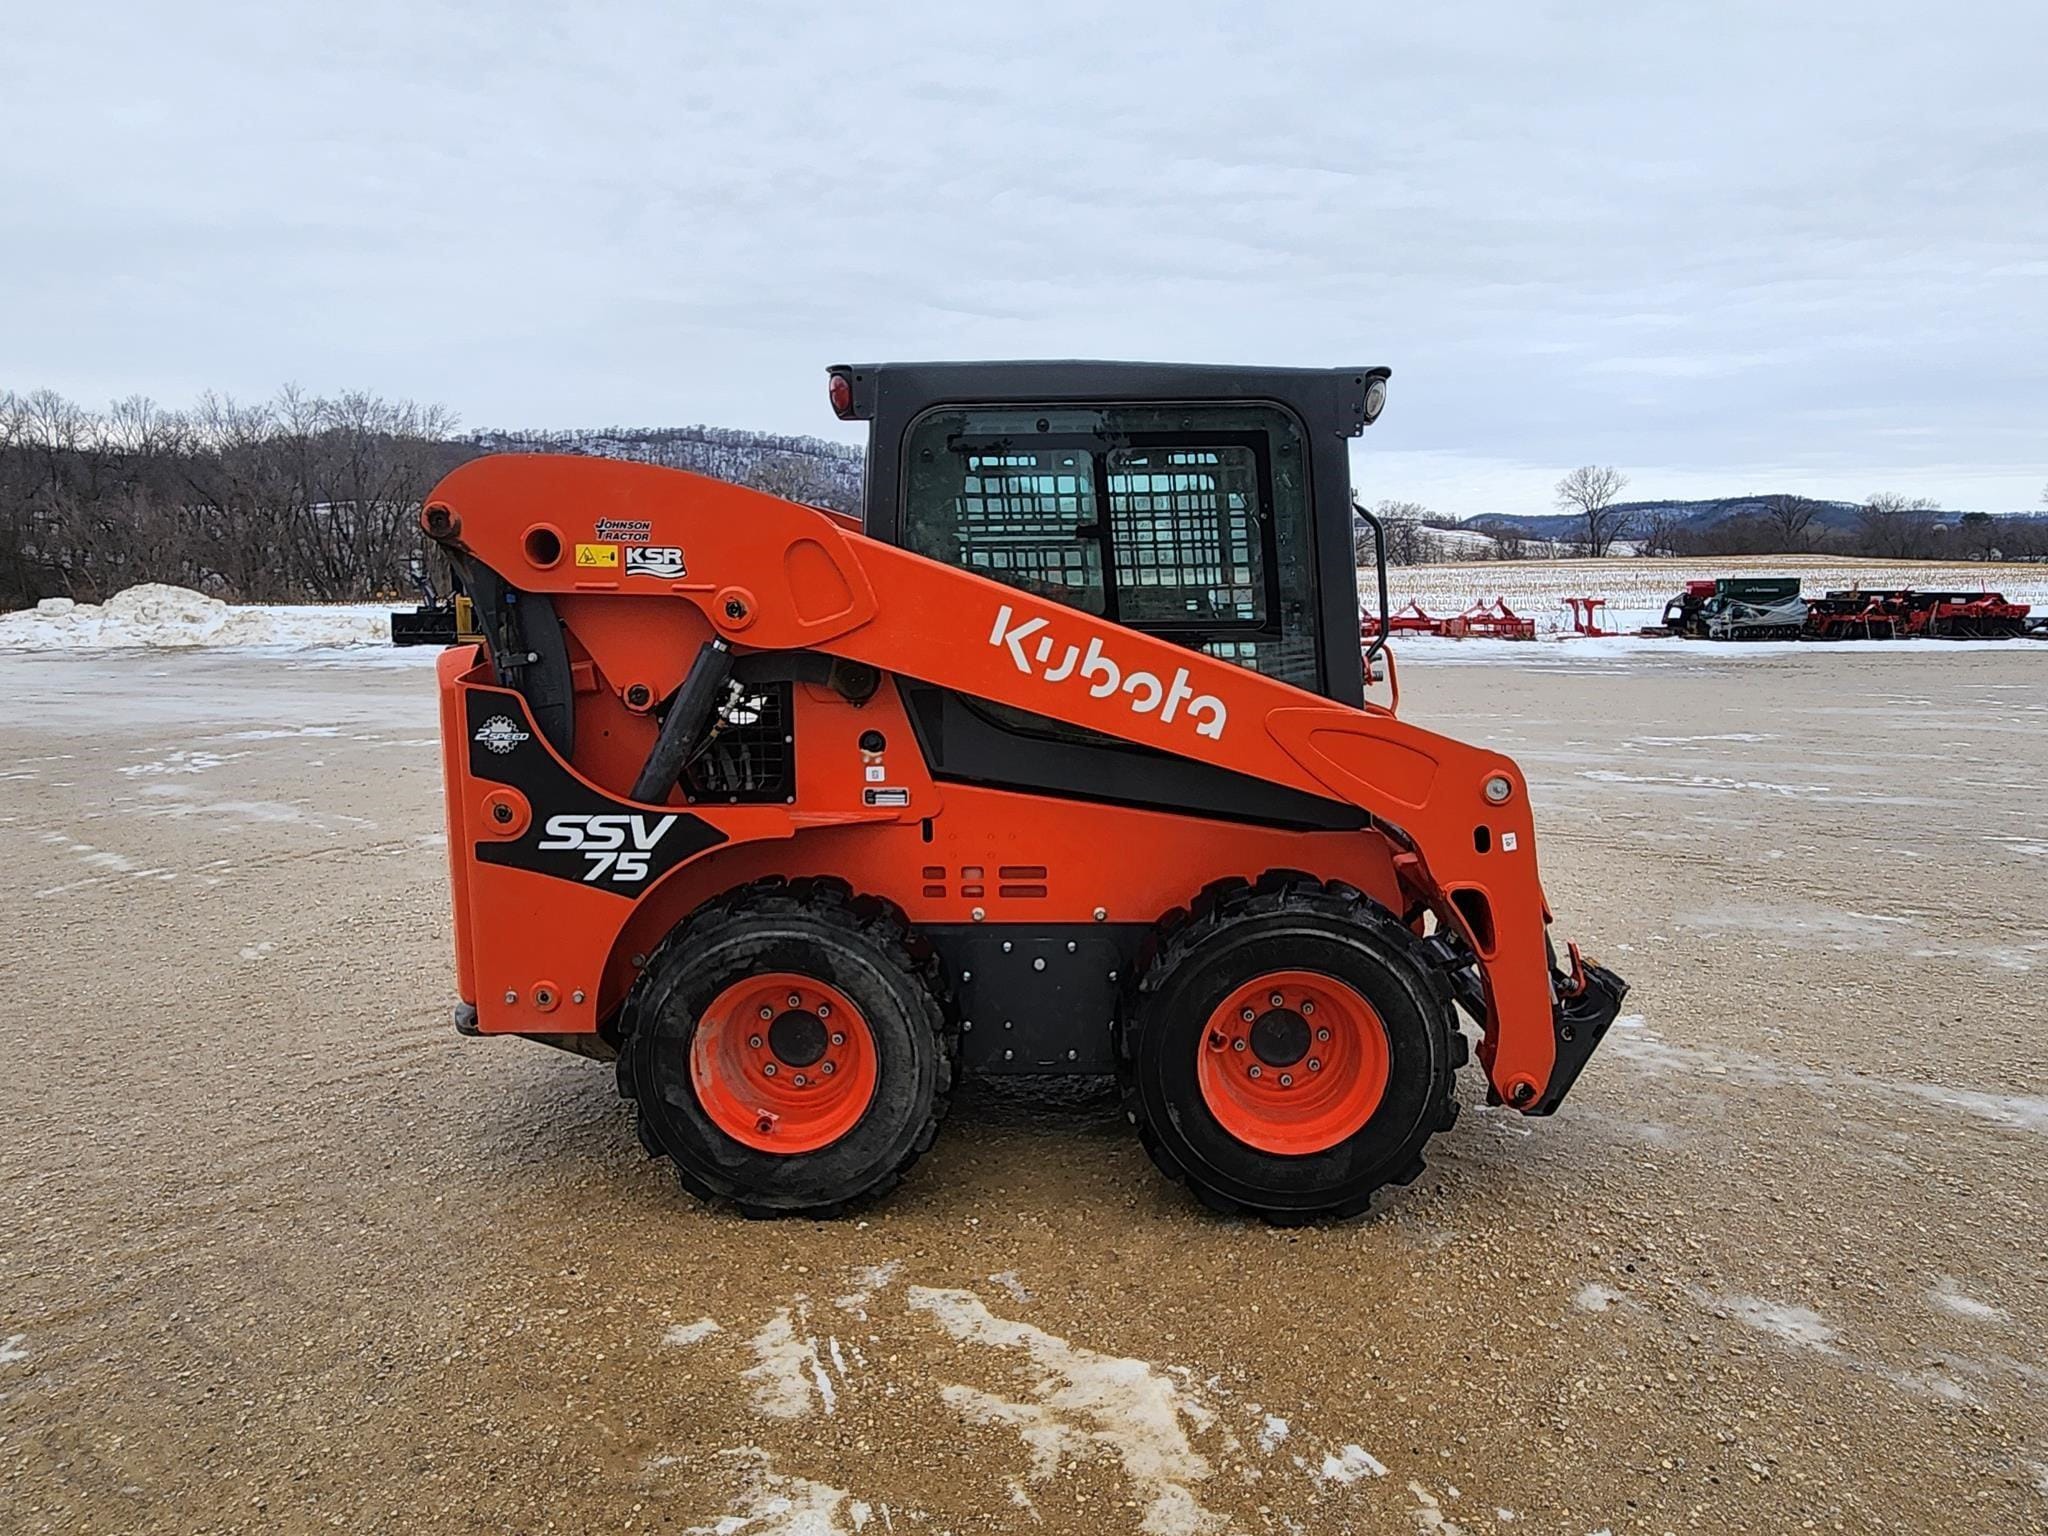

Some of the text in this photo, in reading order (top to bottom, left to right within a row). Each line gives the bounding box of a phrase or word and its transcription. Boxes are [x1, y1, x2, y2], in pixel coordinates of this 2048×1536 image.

[595, 518, 650, 530] JOHNSON
[597, 530, 649, 541] TRACTOR
[626, 547, 682, 564] KSR
[989, 605, 1227, 740] Kubota
[538, 815, 678, 850] SSV
[582, 852, 651, 881] 75
